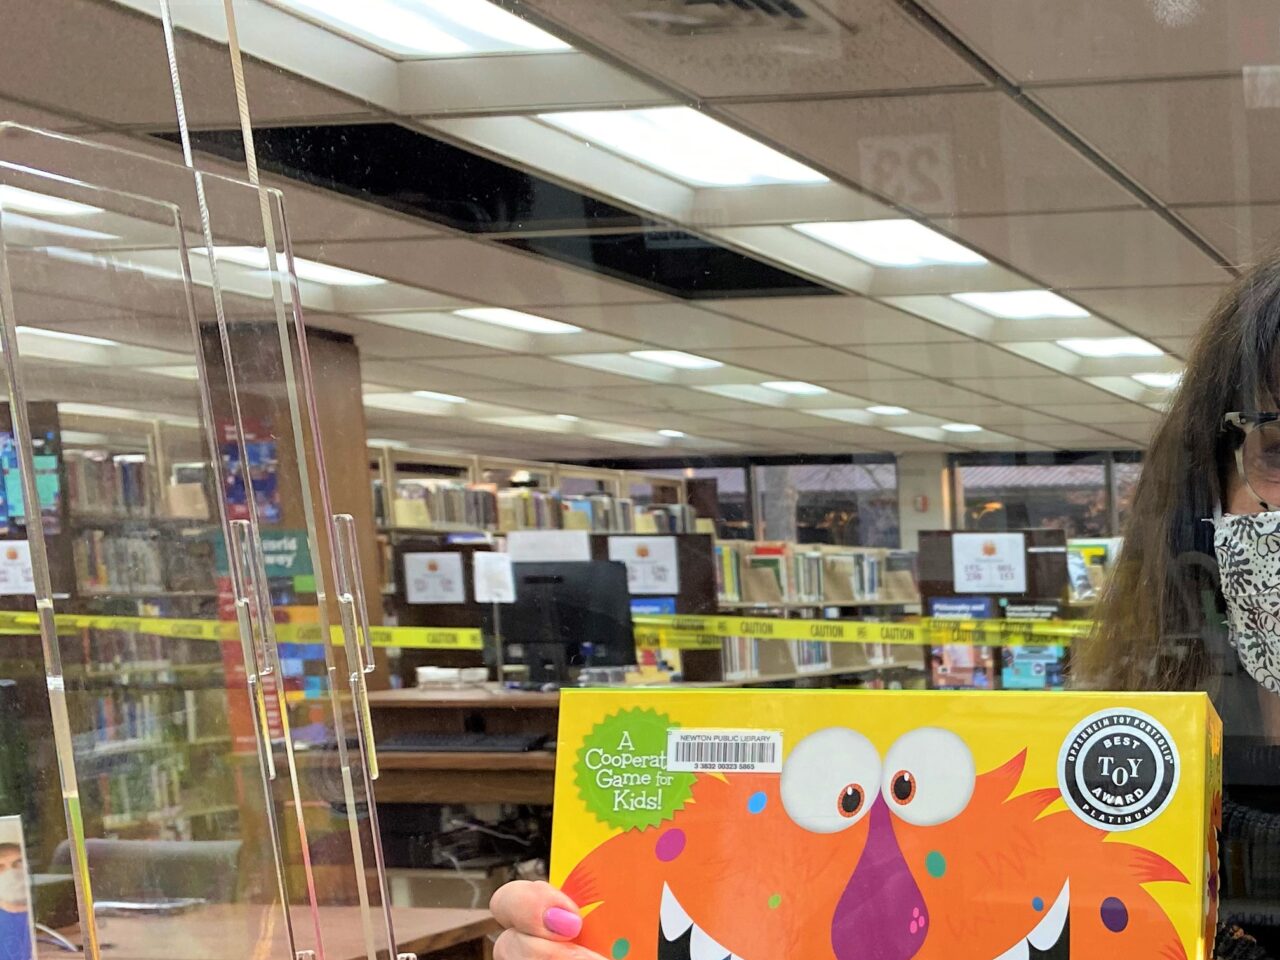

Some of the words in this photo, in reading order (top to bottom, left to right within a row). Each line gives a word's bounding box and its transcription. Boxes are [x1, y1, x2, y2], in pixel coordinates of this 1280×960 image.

[741, 622, 773, 634] CAUTION
[810, 624, 844, 637] CAUTION
[880, 627, 914, 640] CAUTION
[952, 629, 985, 642] CAUTION
[426, 632, 458, 643] CAUTION
[617, 731, 635, 750] A
[1068, 717, 1110, 762] OPPENHEIM
[1113, 716, 1131, 725] TOY
[1103, 736, 1141, 749] BEST
[585, 749, 668, 770] Cooperat
[596, 769, 651, 789] Game
[655, 773, 674, 787] for
[1098, 756, 1143, 786] TOY
[613, 790, 662, 811] Kids!
[1092, 787, 1144, 805] AWARD
[1082, 803, 1153, 823] PLATINUM
